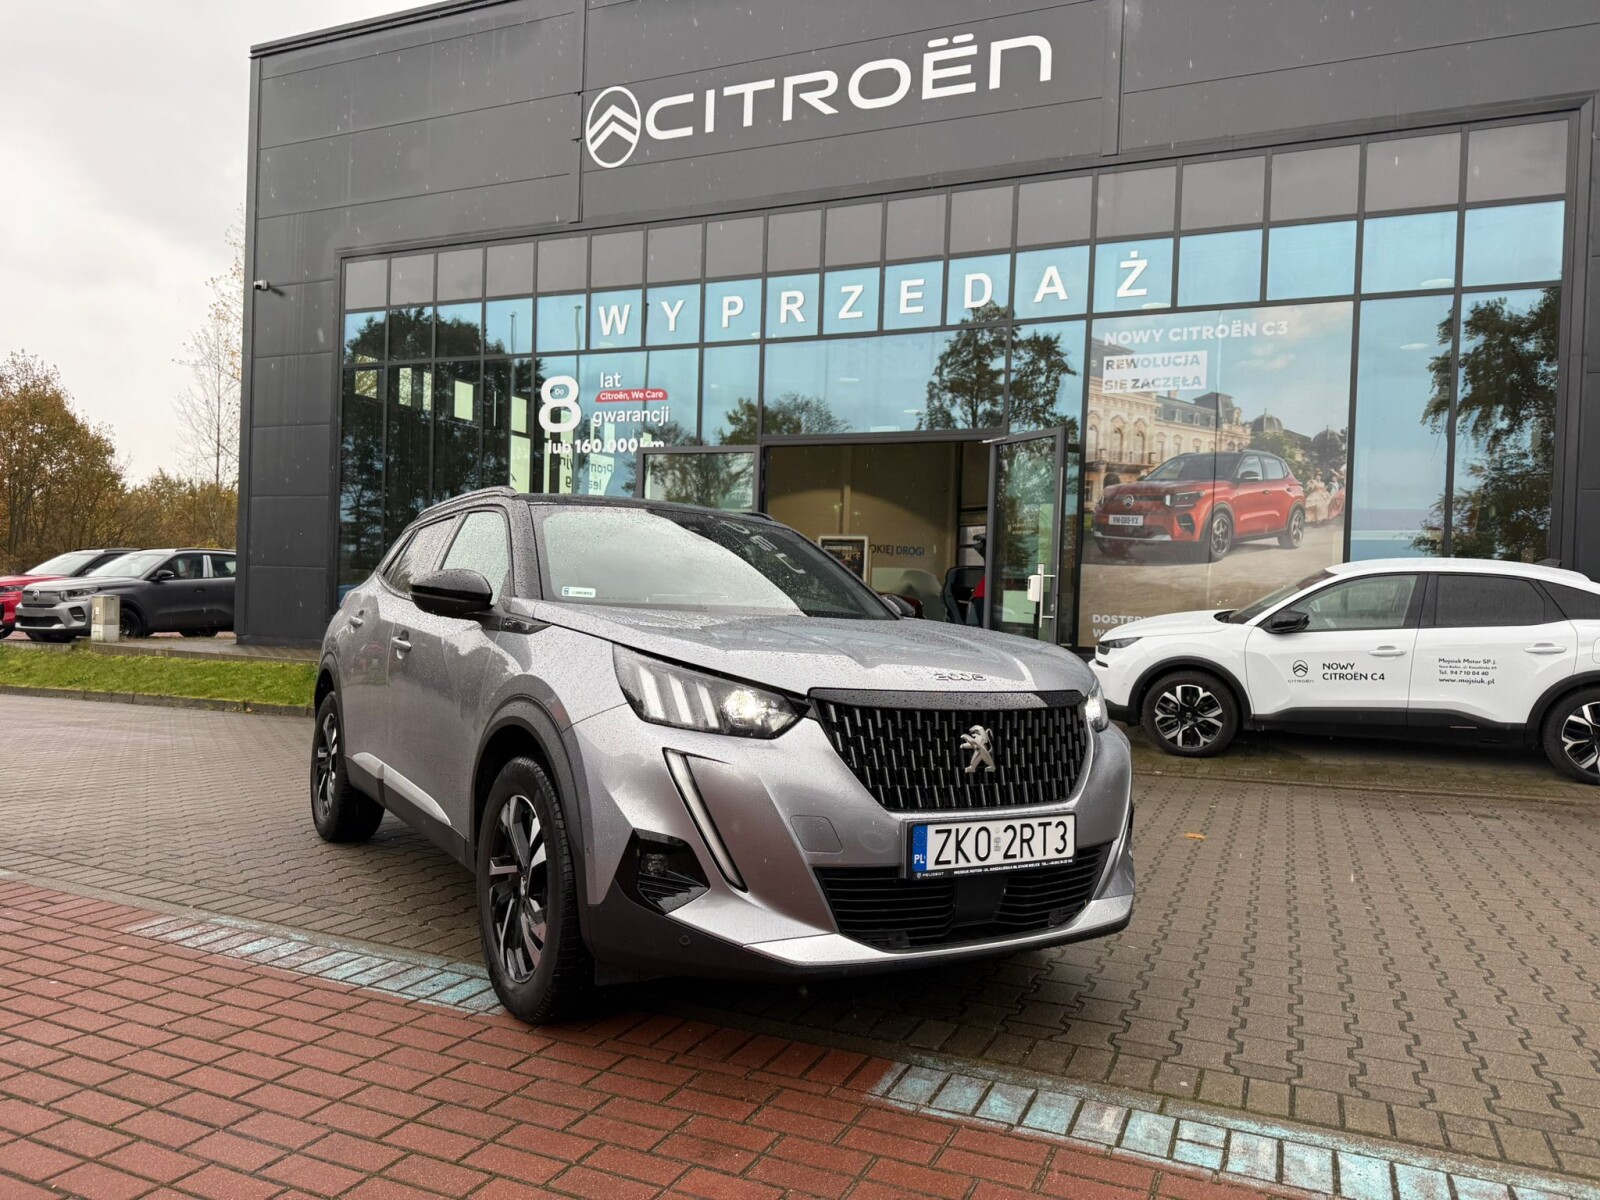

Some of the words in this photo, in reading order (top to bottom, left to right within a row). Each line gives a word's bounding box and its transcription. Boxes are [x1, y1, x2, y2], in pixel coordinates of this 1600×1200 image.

[645, 33, 1053, 141] CITROËN
[1104, 328, 1164, 346] NOWY
[1168, 320, 1257, 342] CITROËN
[1262, 320, 1289, 336] C3
[1105, 354, 1201, 371] REWOLUCJA
[538, 375, 582, 433] 8
[600, 372, 622, 388] lat
[600, 391, 630, 401] Citroën,
[631, 390, 644, 399] We
[645, 390, 663, 399] Care
[592, 406, 669, 427] gwarancji
[548, 440, 573, 455] lub
[575, 438, 638, 453] 160.000
[896, 545, 925, 556] DROGI
[1322, 662, 1355, 670] NOWY
[1322, 671, 1368, 681] CITROËN
[1370, 673, 1385, 681] C4
[1003, 820, 1068, 860] 2RT3
[914, 854, 925, 864] PL
